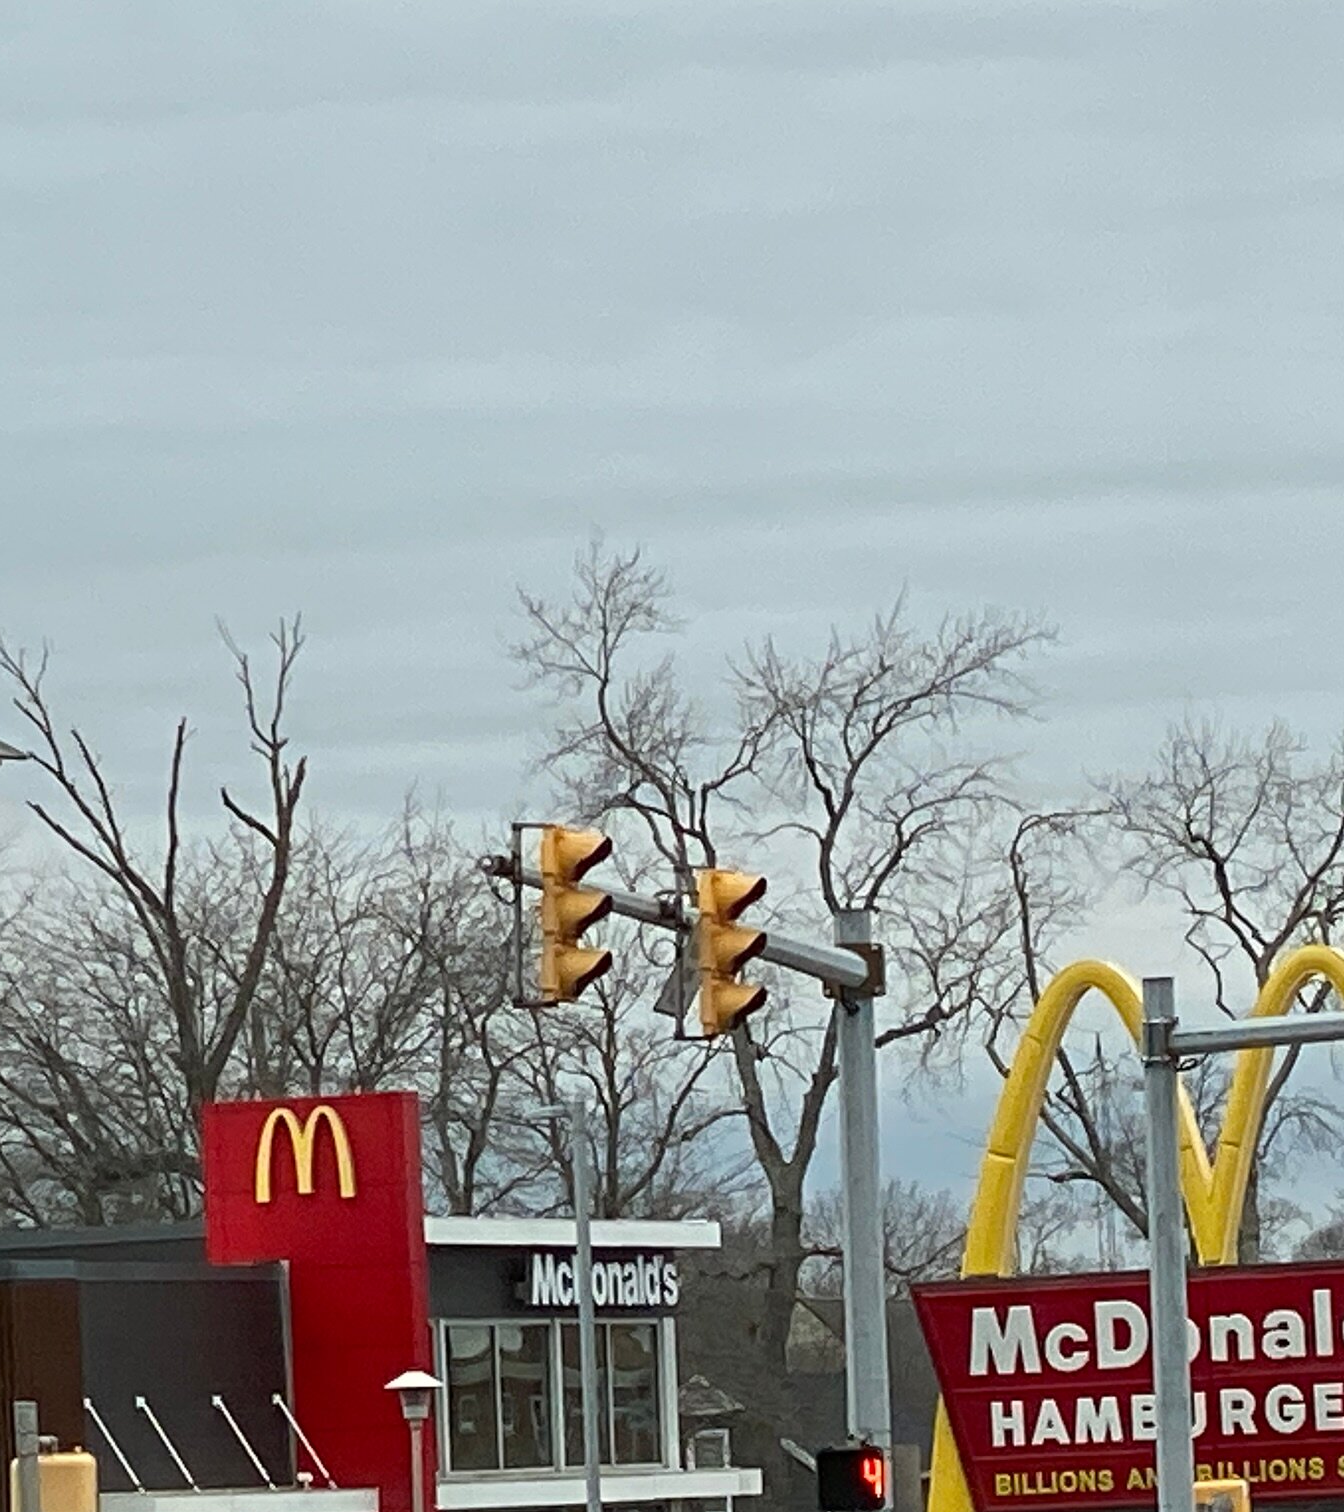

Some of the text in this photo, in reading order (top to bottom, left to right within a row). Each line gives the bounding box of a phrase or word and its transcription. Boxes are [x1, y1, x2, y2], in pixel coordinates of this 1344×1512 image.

[531, 1252, 680, 1307] Mconald's
[863, 1457, 883, 1498] 4
[994, 1469, 1114, 1497] BILLIONS
[1126, 1466, 1159, 1491] AN
[1195, 1455, 1325, 1484] BILLIONS
